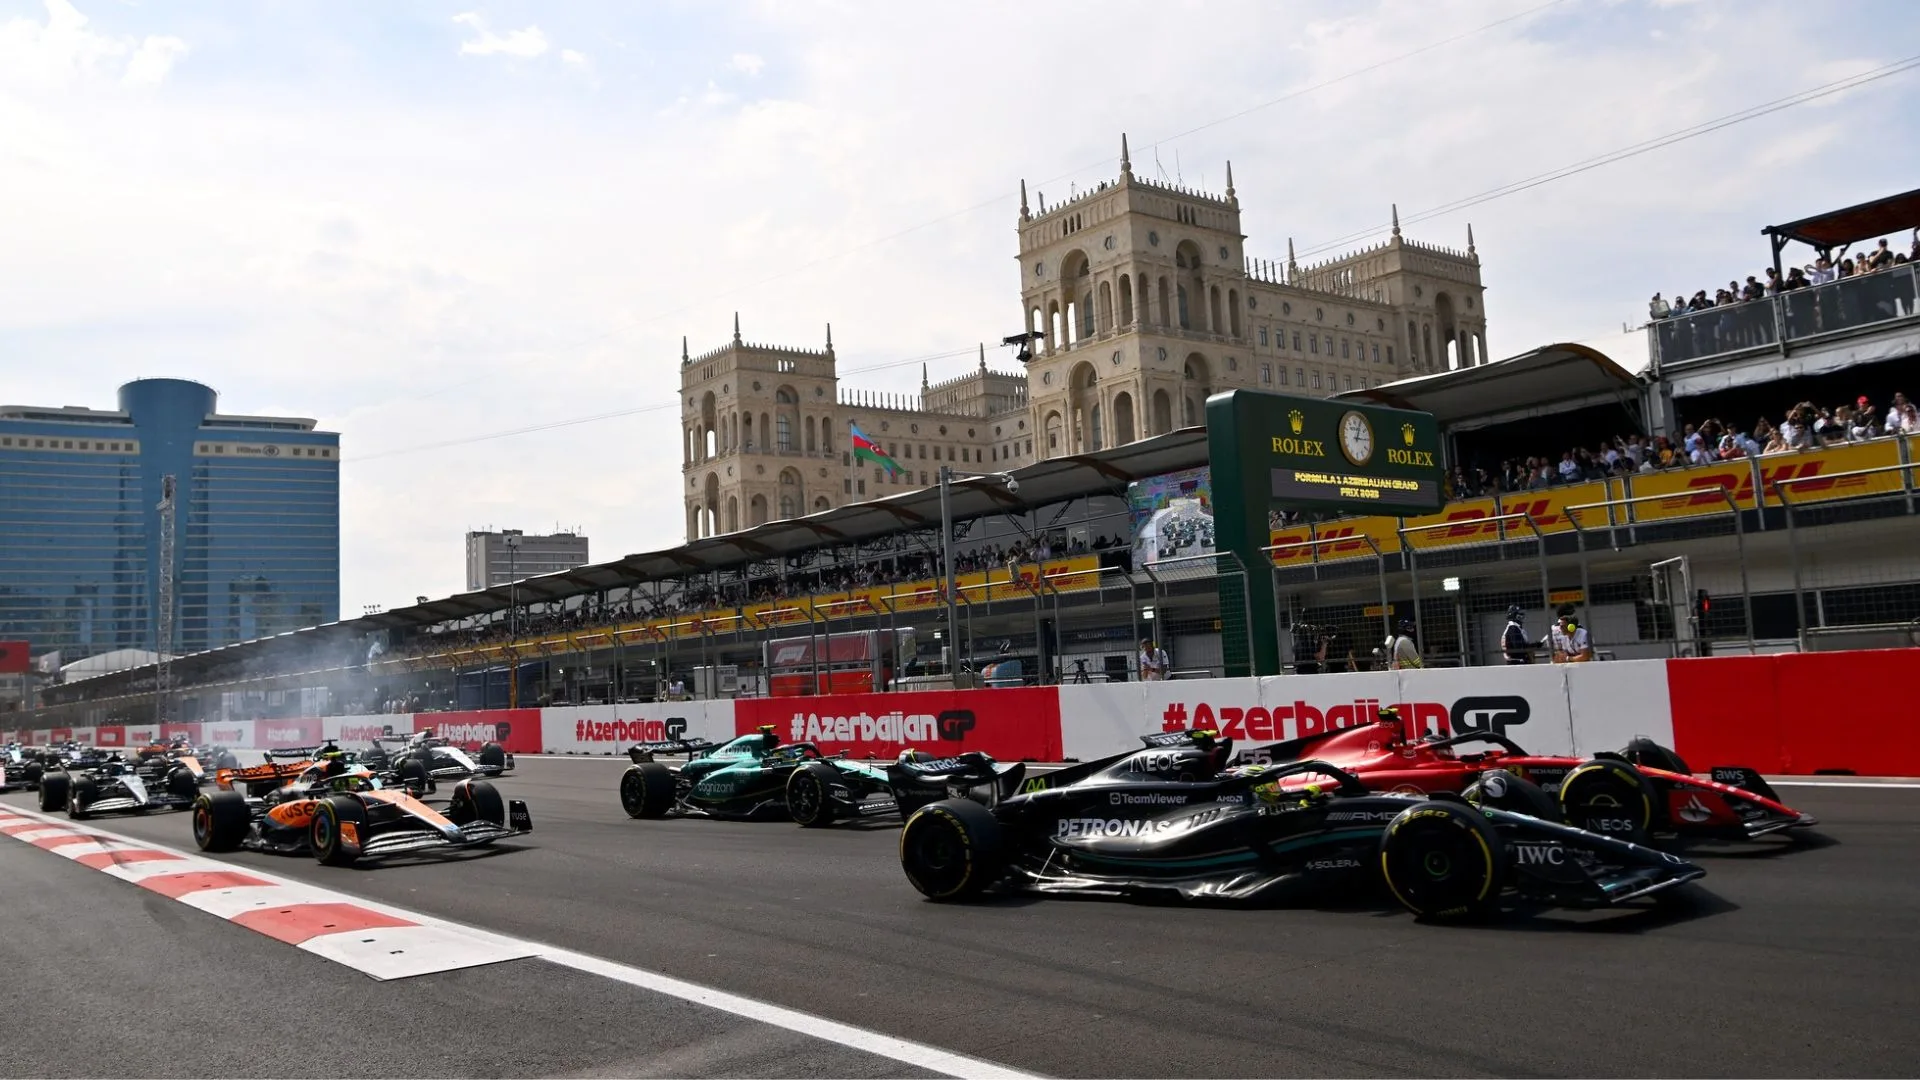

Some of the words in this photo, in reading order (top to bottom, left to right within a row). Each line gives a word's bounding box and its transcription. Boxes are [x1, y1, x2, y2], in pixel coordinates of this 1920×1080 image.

[1271, 437, 1325, 457] ROLEX
[1387, 448, 1434, 467] ROLEX
[1294, 472, 1336, 484] FORMULA
[1392, 480, 1419, 491] GRAND
[1688, 460, 1836, 506] DHL
[1339, 487, 1360, 498] PRIX
[1446, 499, 1560, 537] DHL
[1271, 527, 1361, 560] DHL
[1130, 752, 1184, 773] INEOS
[1239, 749, 1273, 767] 55
[1715, 770, 1745, 780] aws
[697, 782, 735, 796] cognizant
[1026, 777, 1047, 793] 44
[1121, 793, 1188, 805] TeamViewer
[1058, 818, 1170, 838] PETRONAS
[1586, 819, 1633, 831] INEOS
[1314, 859, 1361, 870] SOLERA
[1517, 846, 1565, 865] IWC
